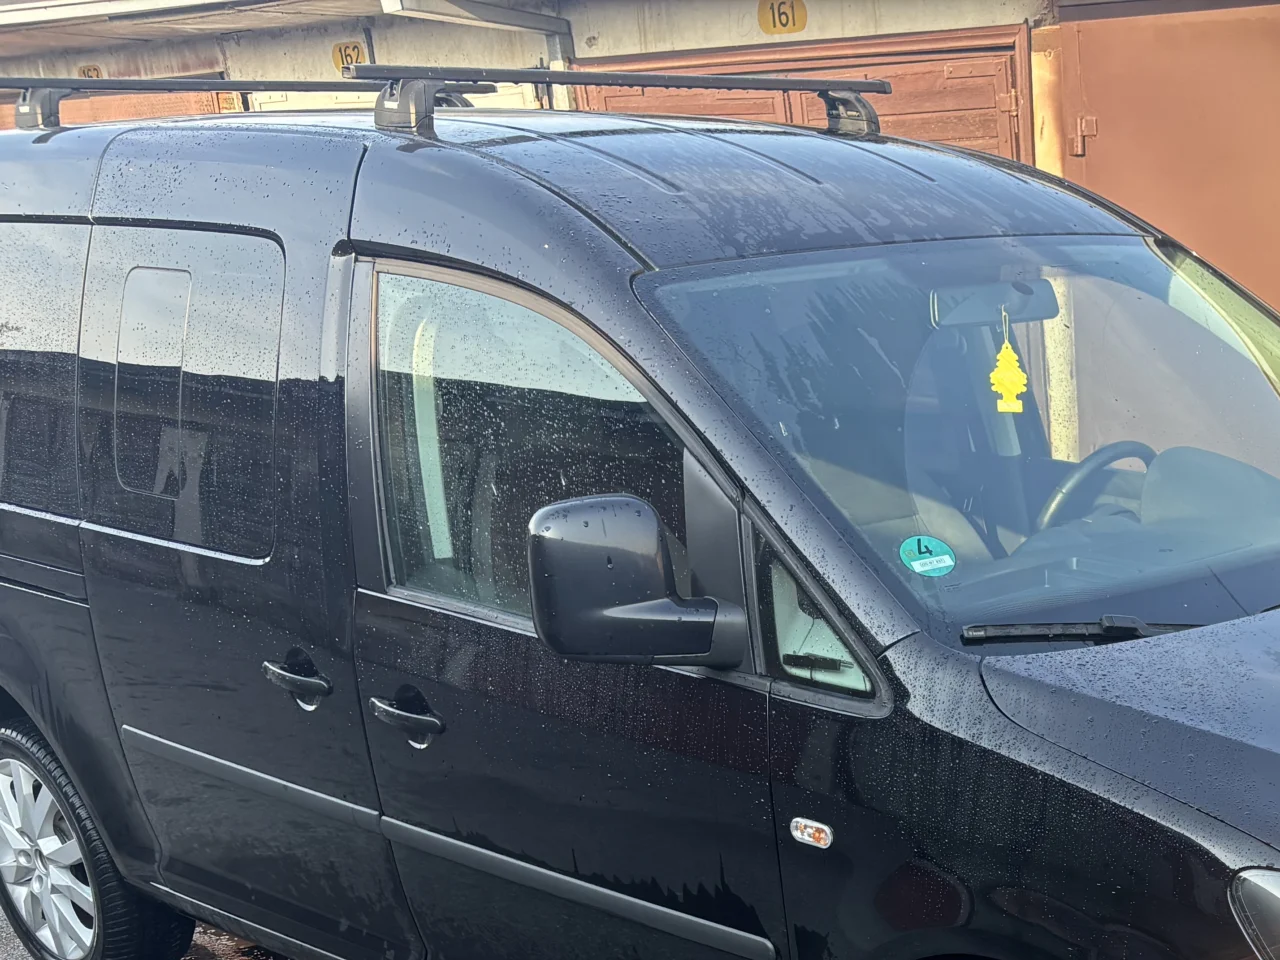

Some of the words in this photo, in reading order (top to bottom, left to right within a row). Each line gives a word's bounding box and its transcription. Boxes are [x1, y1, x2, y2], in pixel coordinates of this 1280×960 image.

[769, 0, 796, 28] 161
[338, 44, 362, 65] 162
[917, 538, 933, 556] 4
